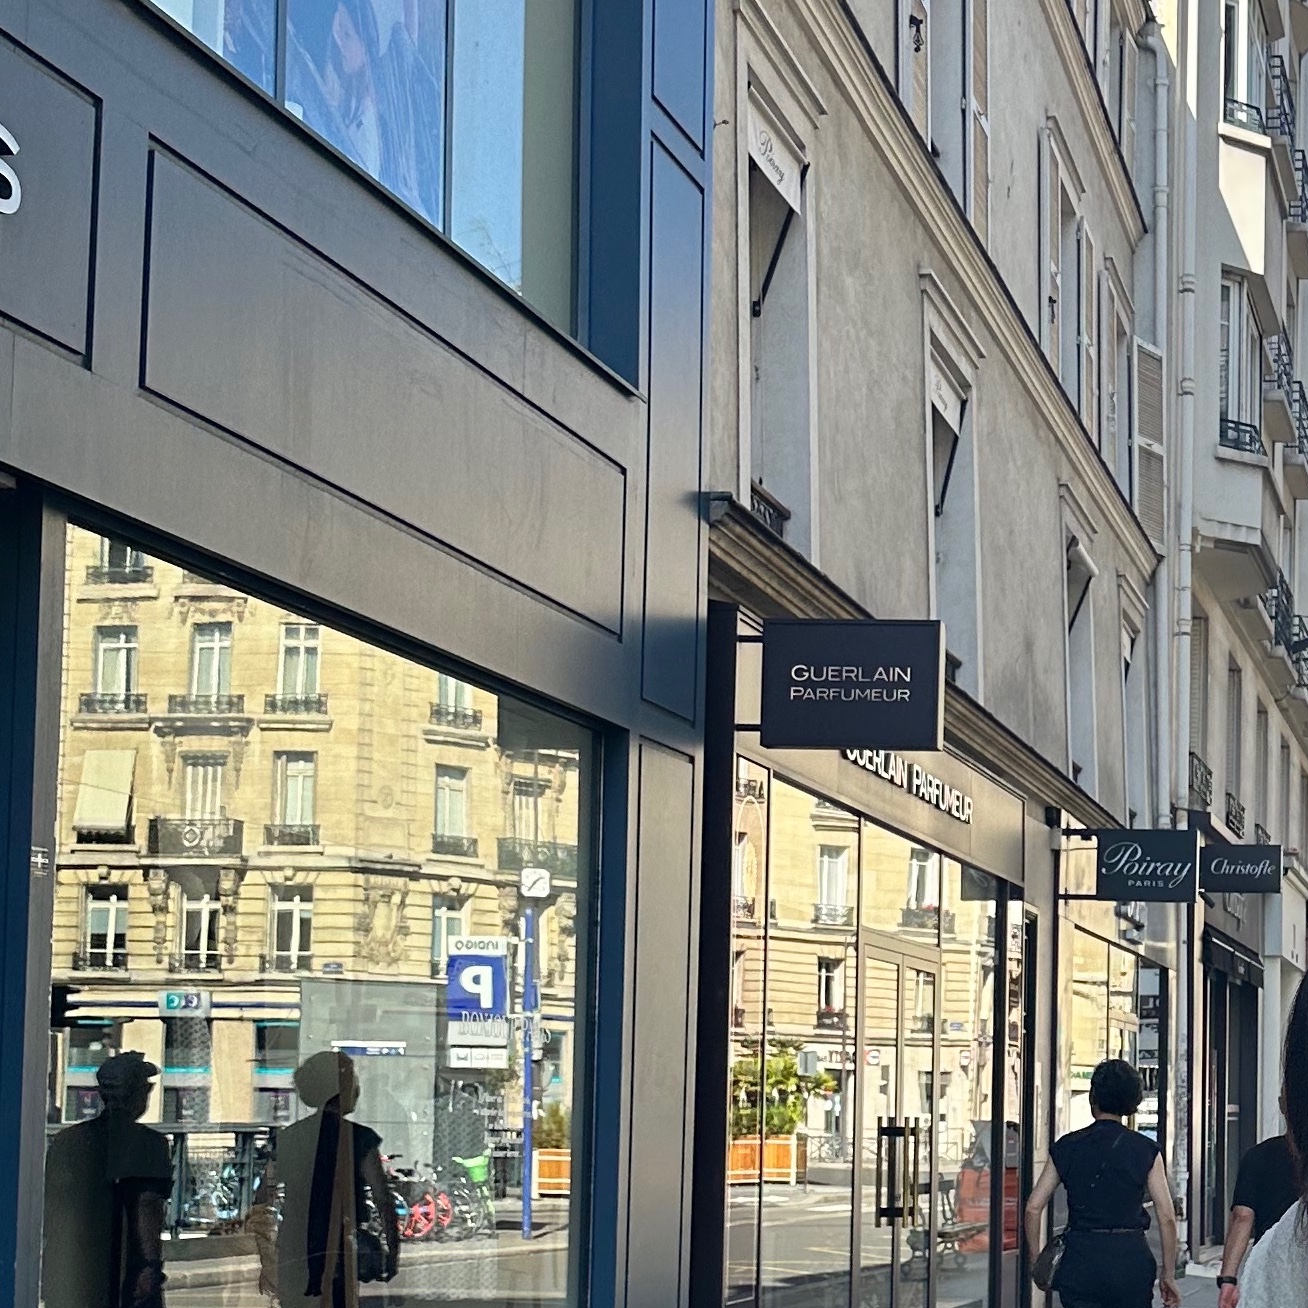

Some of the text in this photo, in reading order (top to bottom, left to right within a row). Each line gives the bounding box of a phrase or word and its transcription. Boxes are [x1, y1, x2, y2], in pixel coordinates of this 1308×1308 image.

[790, 664, 911, 682] GUERLAIN
[789, 686, 910, 702] PARFUMEUR
[912, 763, 973, 825] PARFUMEUR
[1101, 841, 1192, 889] Poiray
[1210, 857, 1276, 879] Christofle
[1127, 879, 1165, 887] PARIS
